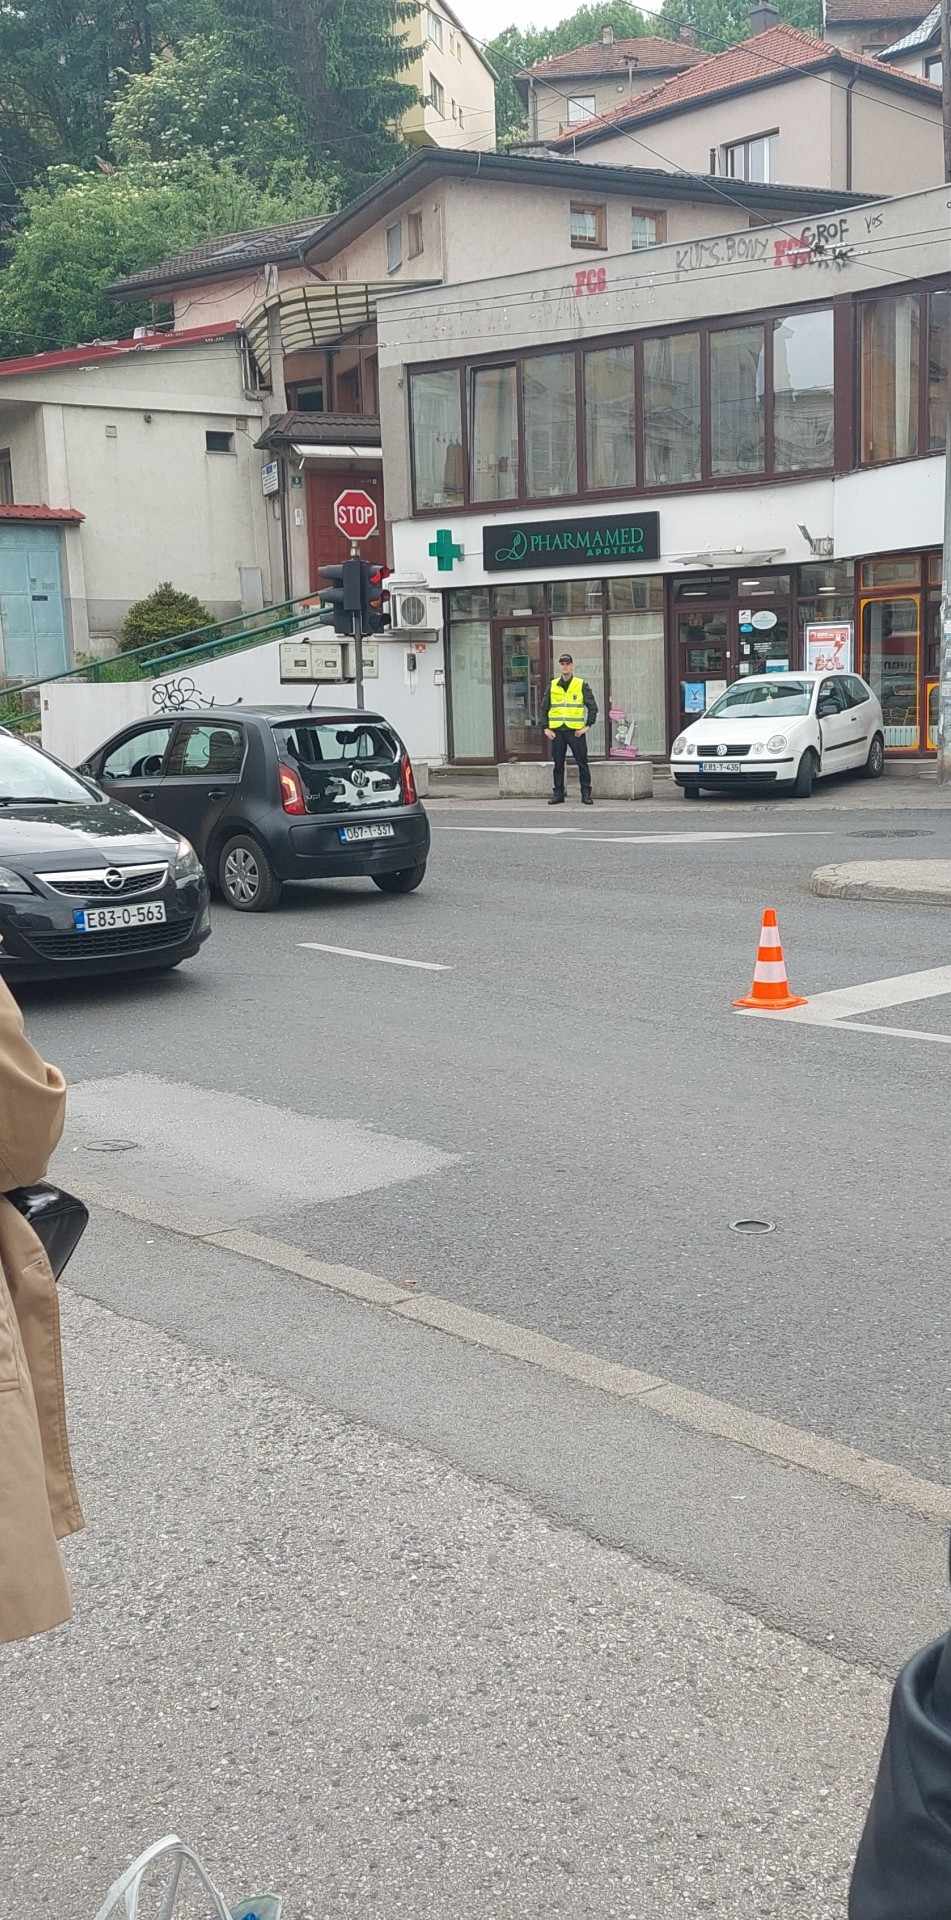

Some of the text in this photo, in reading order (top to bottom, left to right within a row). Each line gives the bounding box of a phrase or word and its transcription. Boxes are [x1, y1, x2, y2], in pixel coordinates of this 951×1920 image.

[338, 506, 373, 524] STOP
[530, 527, 644, 552] PHARMAMED
[586, 545, 644, 556] APOTEKA
